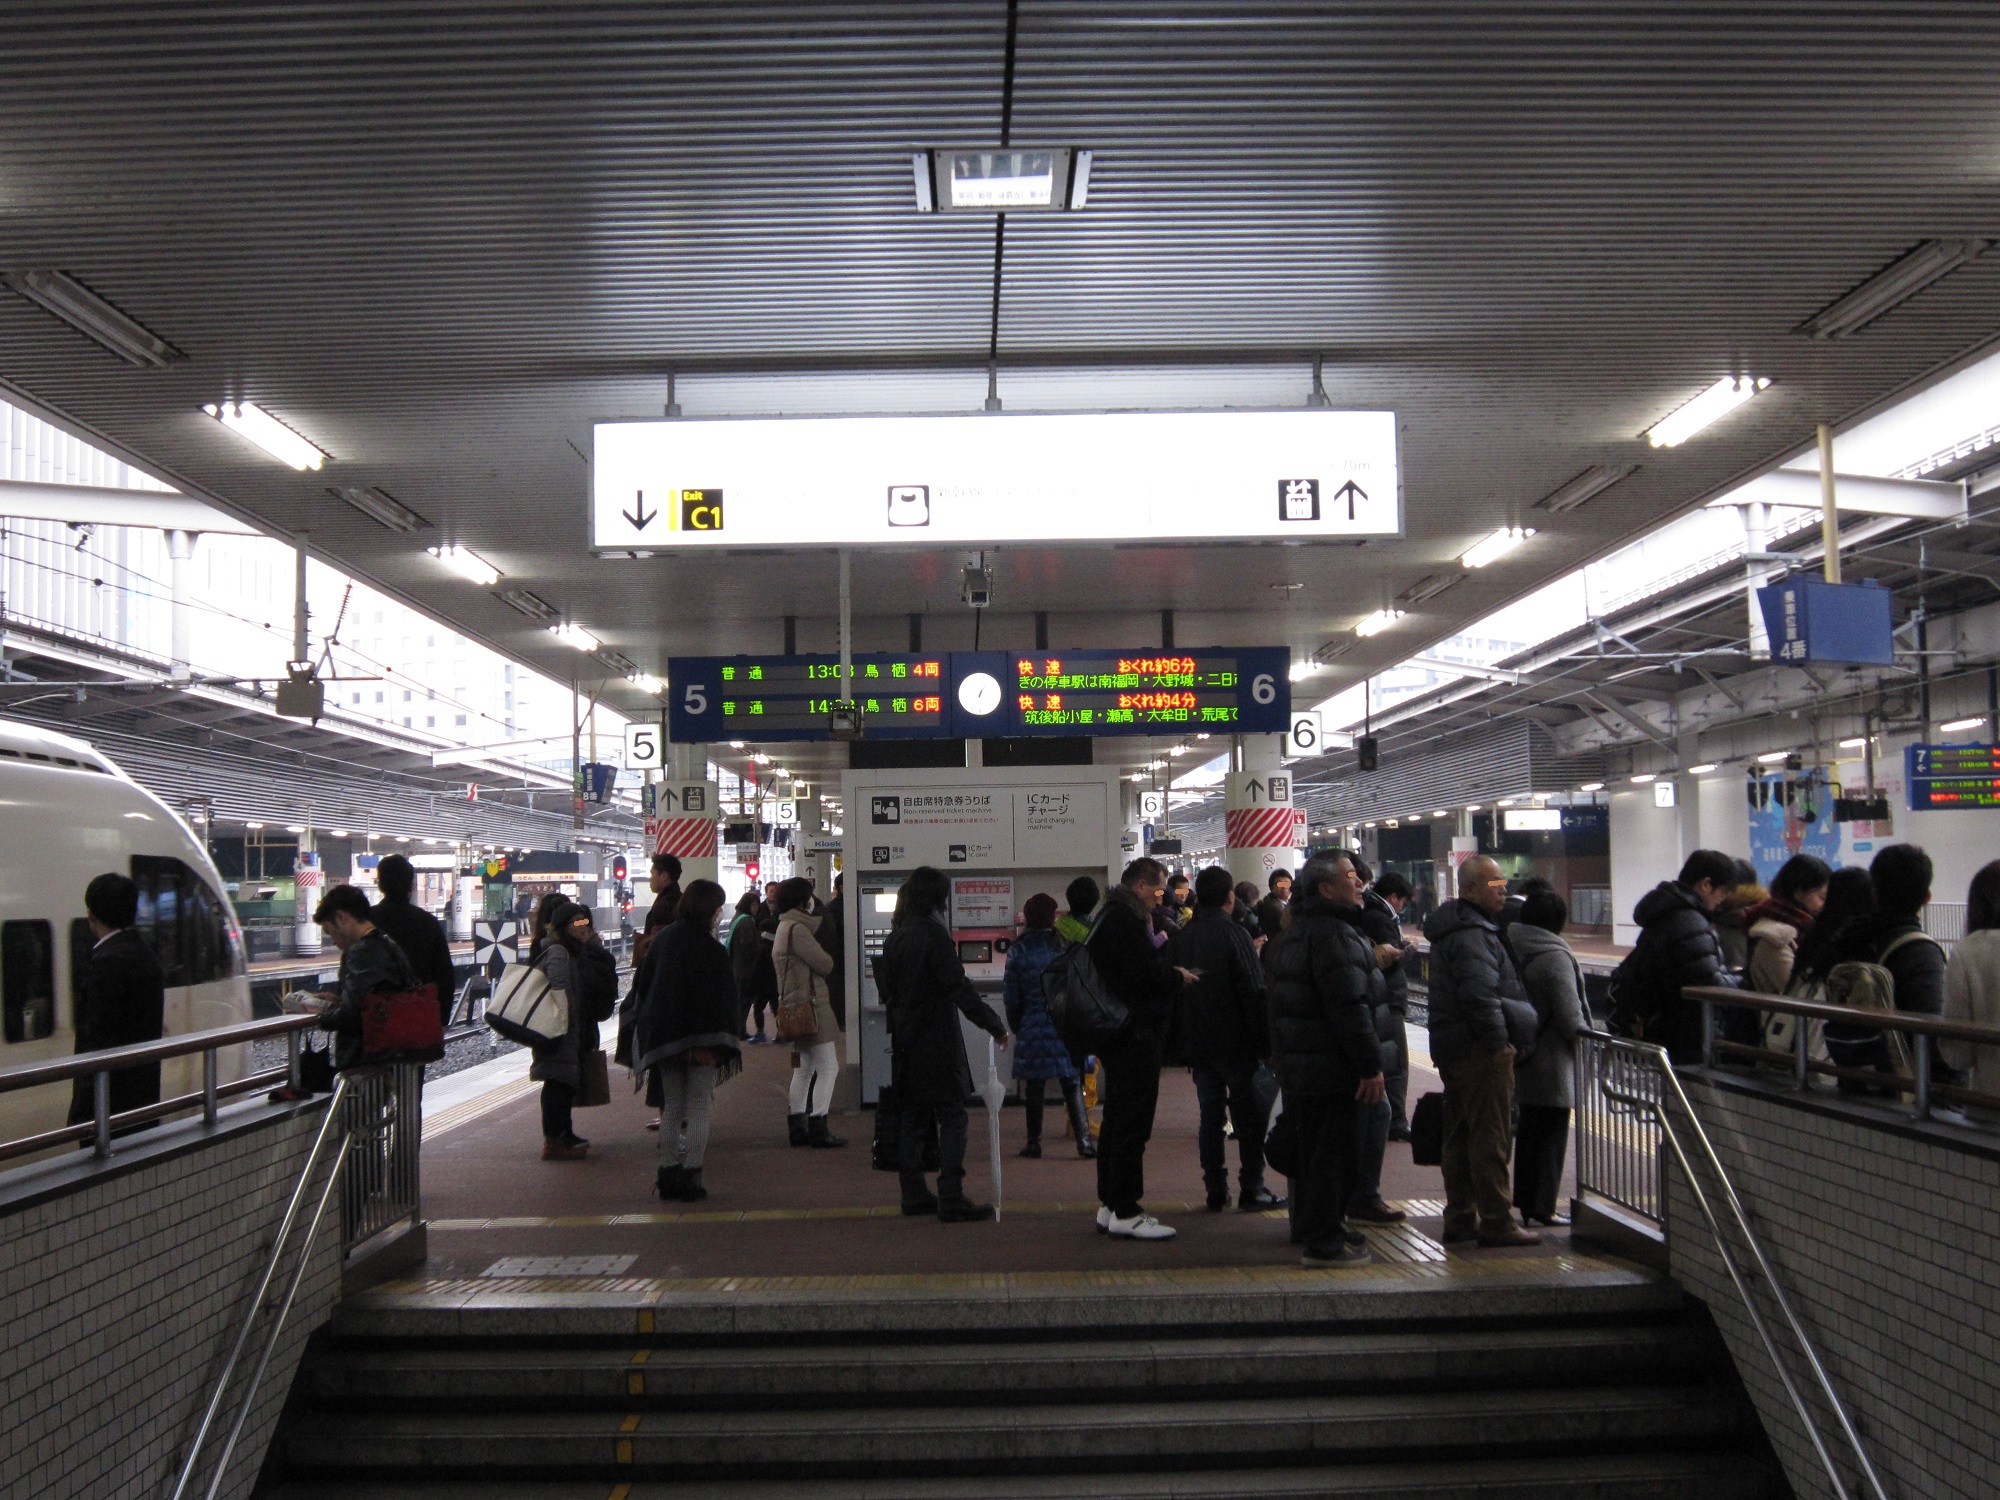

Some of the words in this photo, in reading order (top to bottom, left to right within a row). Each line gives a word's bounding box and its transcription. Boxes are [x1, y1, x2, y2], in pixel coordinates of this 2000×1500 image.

[683, 491, 703, 501] Exit
[690, 506, 721, 530] C1
[1780, 640, 1807, 660] 4番
[721, 666, 763, 680] 普通
[865, 663, 906, 678] 鳥栖
[913, 661, 940, 677] 4両
[1018, 659, 1061, 675] 快速
[1119, 657, 1196, 674] おくれ約6分
[1252, 673, 1276, 704] 6
[684, 685, 707, 714] 5
[722, 700, 764, 715] 普通
[809, 698, 856, 714] 14:
[865, 697, 907, 713] 鳥栖
[913, 696, 941, 712] 6両
[1018, 693, 1062, 710] 快速
[1119, 692, 1197, 709] おくれ約4分
[1293, 719, 1316, 748] 6
[632, 732, 655, 761] 5
[1917, 750, 1927, 763] 7
[903, 795, 991, 807] 自由席特急券うりば
[1026, 793, 1070, 805] ICカード
[1660, 786, 1670, 803] 7
[780, 803, 793, 819] 5
[903, 807, 945, 815] Non-reserved
[947, 807, 964, 815] ticket
[965, 806, 992, 815] machine
[1027, 805, 1069, 816] チャージ
[1144, 796, 1158, 813] 6
[968, 844, 993, 852] ICカード
